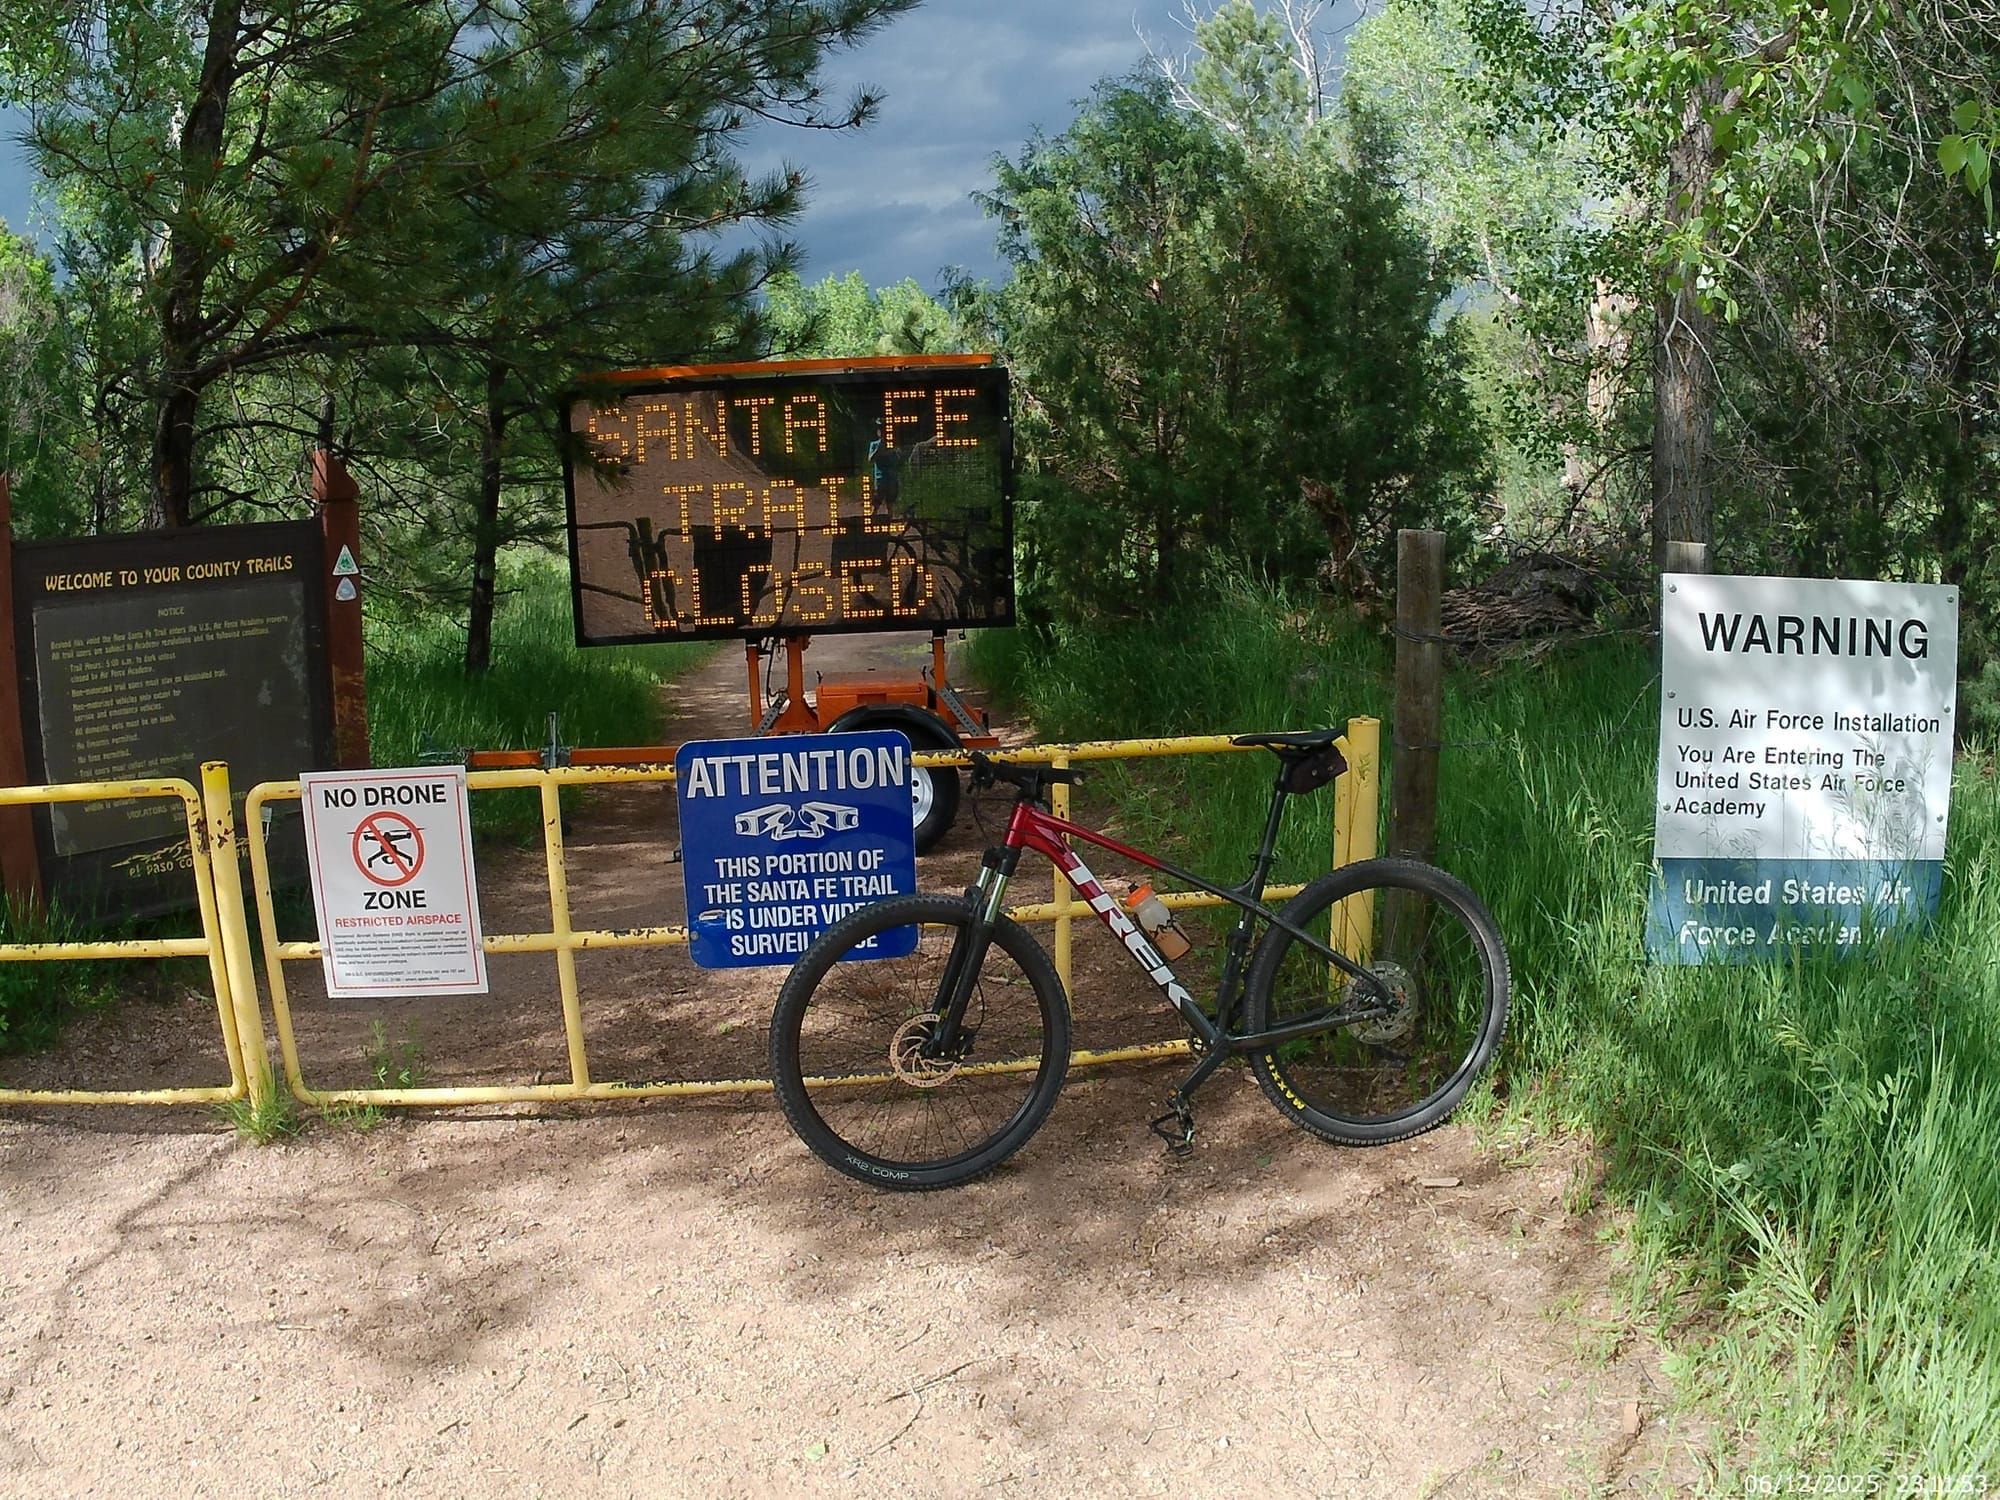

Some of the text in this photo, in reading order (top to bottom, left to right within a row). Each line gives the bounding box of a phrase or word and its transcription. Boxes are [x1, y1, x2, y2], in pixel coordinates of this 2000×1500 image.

[588, 388, 978, 463] SANTA FE
[663, 475, 906, 543] TRAIL
[45, 555, 293, 591] WELCOME TO YOUR COUNTY TRAILS
[643, 557, 933, 629] CLOSED
[158, 606, 185, 618] NOTICE
[1698, 612, 1928, 659] WARNING
[1677, 707, 1940, 734] U.S. Air Force Installation
[1678, 745, 1886, 769] You Are Entering The
[686, 746, 904, 799] ATTENTION
[1675, 771, 1905, 793] United States Air Force
[323, 784, 447, 809] NO DRONE
[1674, 797, 1766, 819] Academy
[714, 849, 884, 879] THIS PORTION OF
[363, 889, 427, 911] ZONE
[703, 874, 899, 905] THE SANTA FE TRAIL
[1684, 879, 1911, 906] United States Air
[334, 913, 463, 928] RESTRICTED AIRSPACE
[725, 901, 876, 930] IS UNDER VID
[730, 931, 879, 956] SURVEILE
[1068, 852, 1194, 1010] TREK
[1679, 920, 1757, 946] Force
[1265, 1054, 1305, 1110] MAXXIS
[845, 1153, 910, 1180] XR2 COMP
